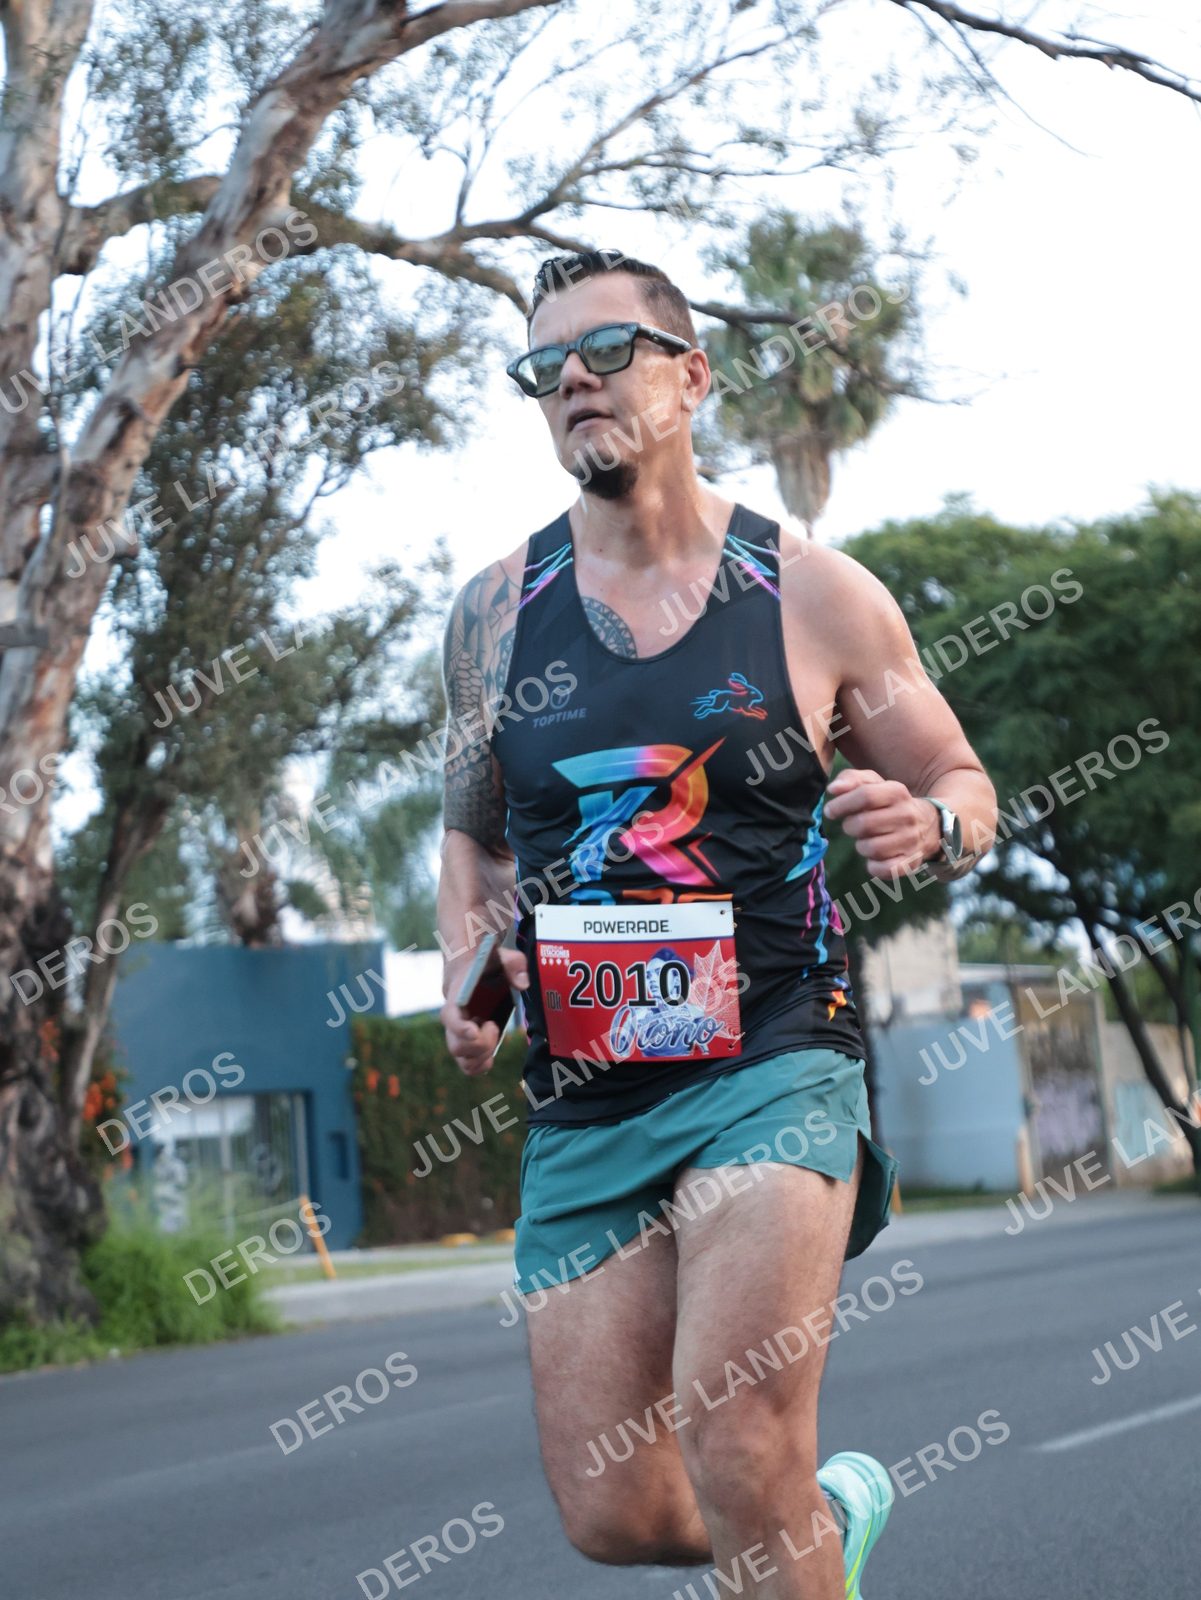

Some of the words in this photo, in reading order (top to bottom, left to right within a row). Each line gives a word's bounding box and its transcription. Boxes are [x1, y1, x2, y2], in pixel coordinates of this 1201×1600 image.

[533, 707, 587, 728] TOPTIME
[583, 919, 670, 934] POWERADE
[567, 960, 691, 1009] 2010
